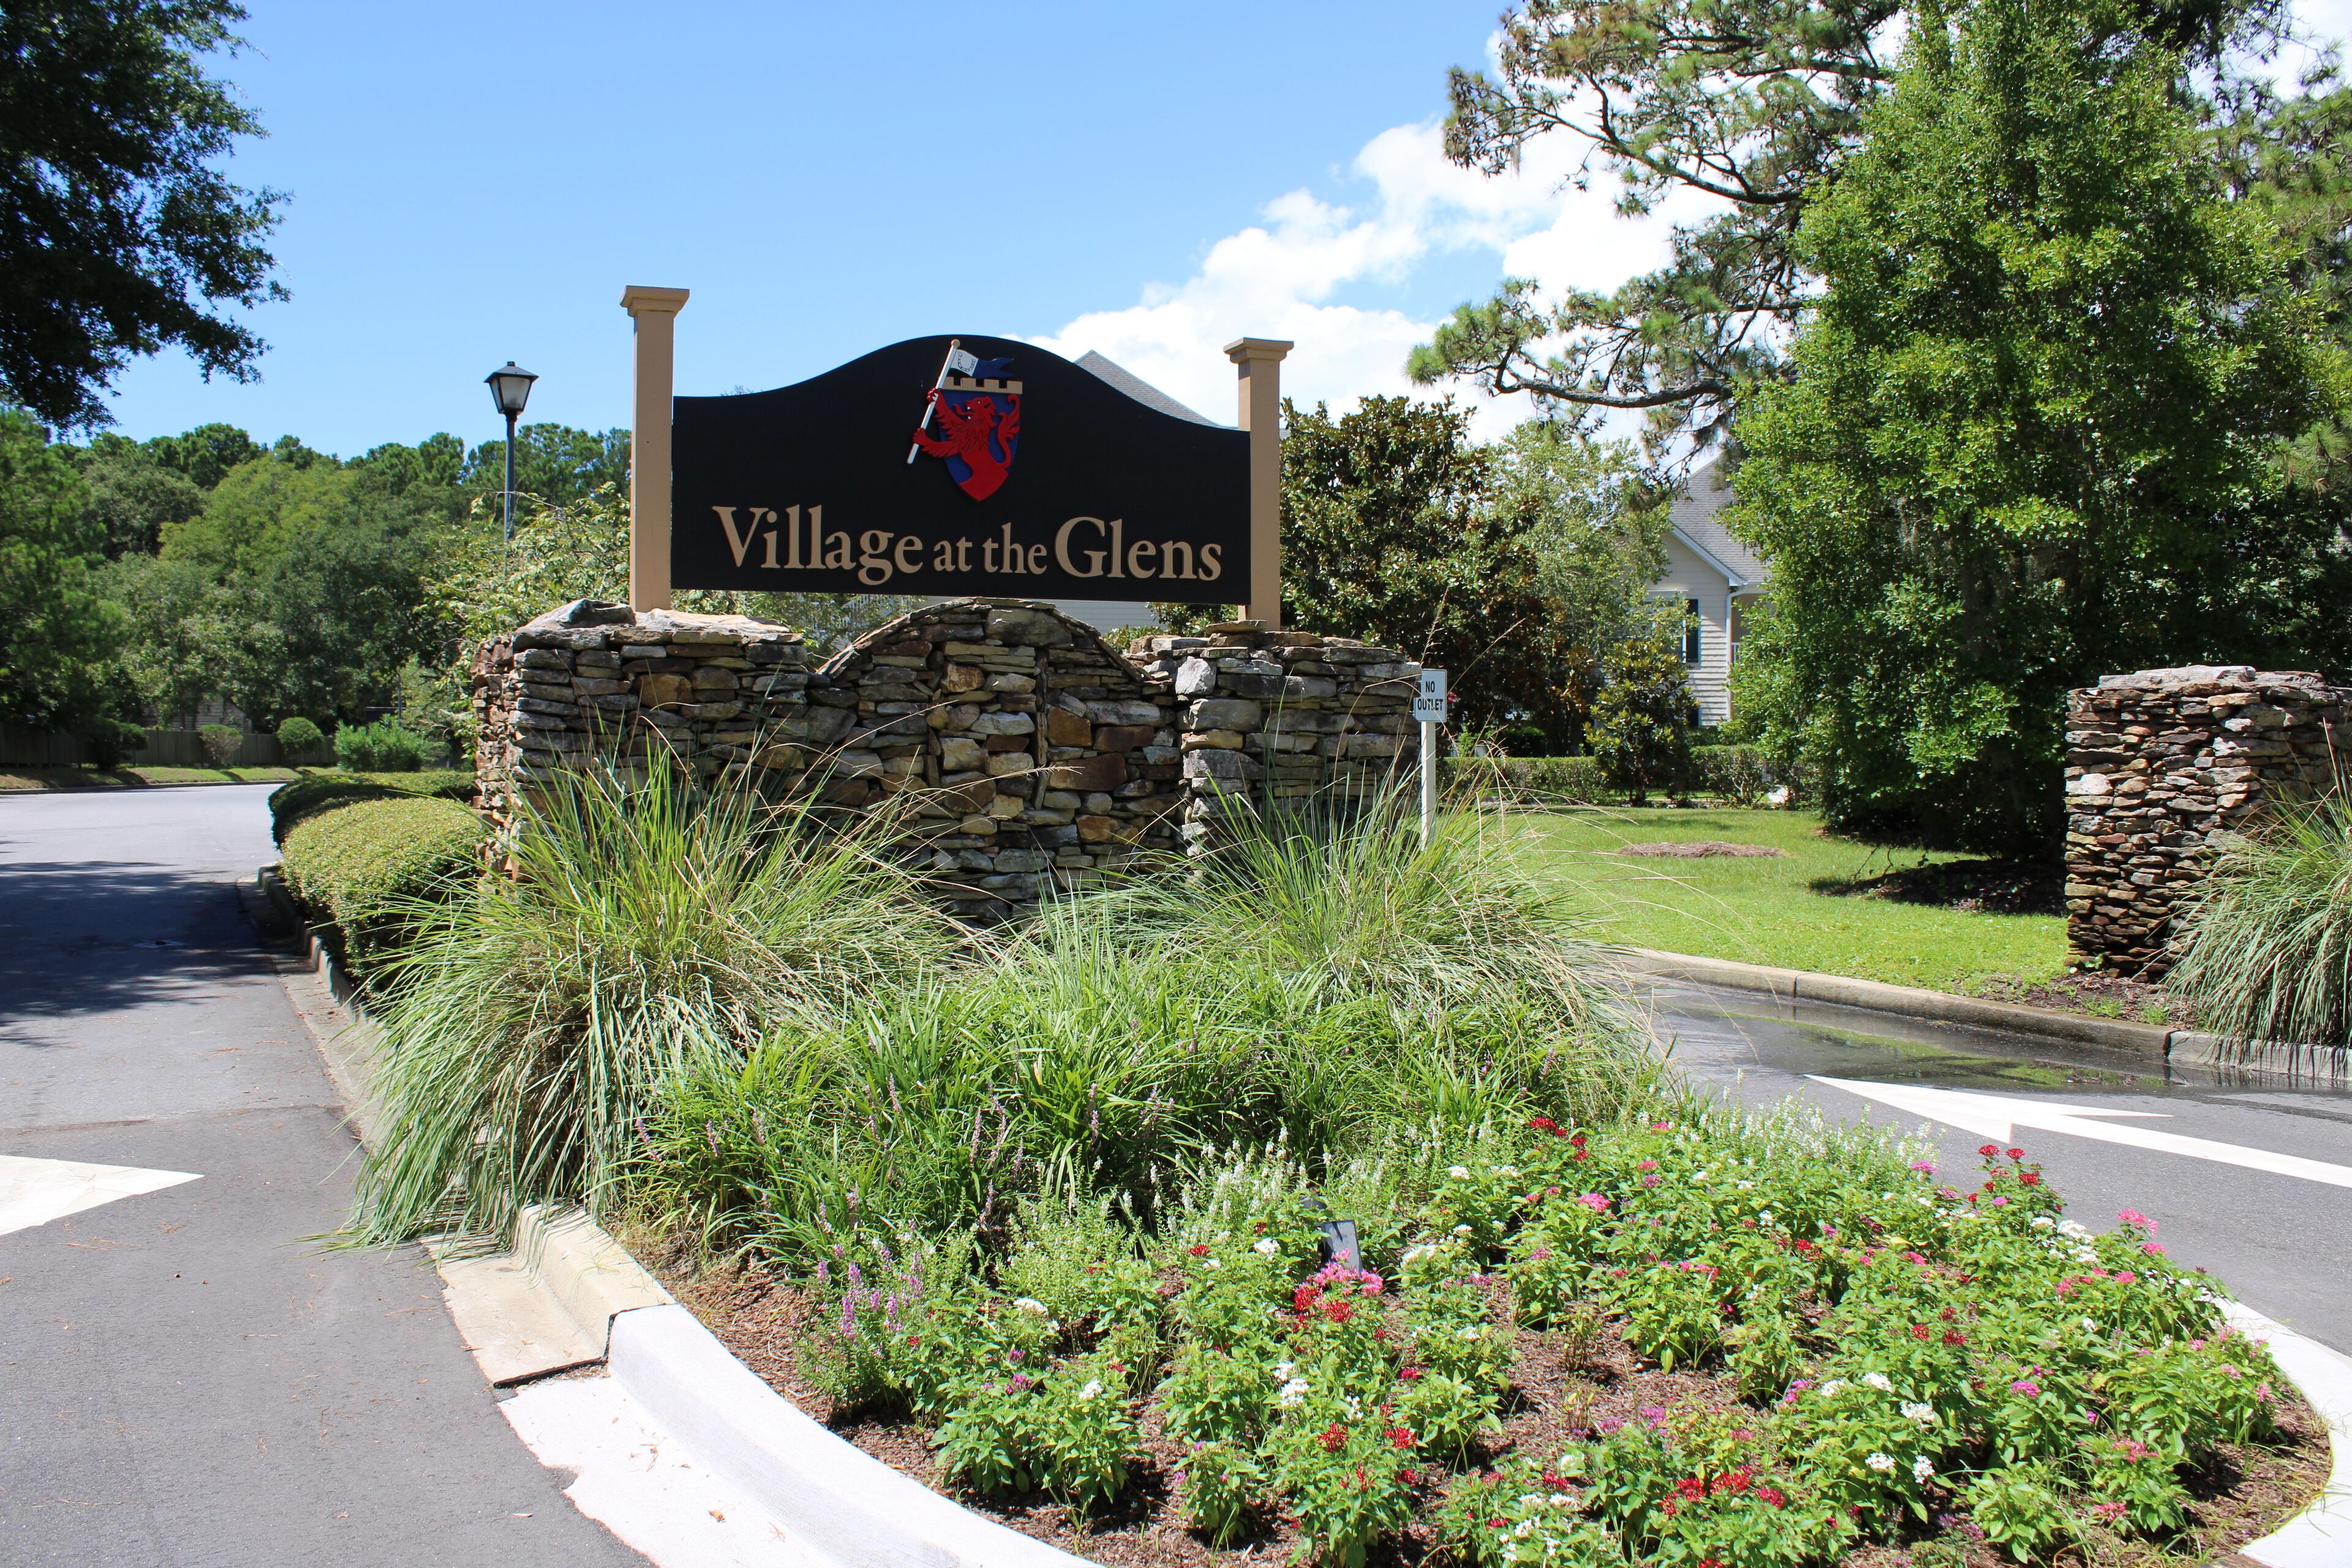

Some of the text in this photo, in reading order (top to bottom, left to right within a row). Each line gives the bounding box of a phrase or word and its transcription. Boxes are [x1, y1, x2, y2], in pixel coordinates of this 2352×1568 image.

[712, 504, 1222, 586] Village at the Glens
[1425, 680, 1435, 693] NO
[1417, 698, 1443, 710] OUTLET
